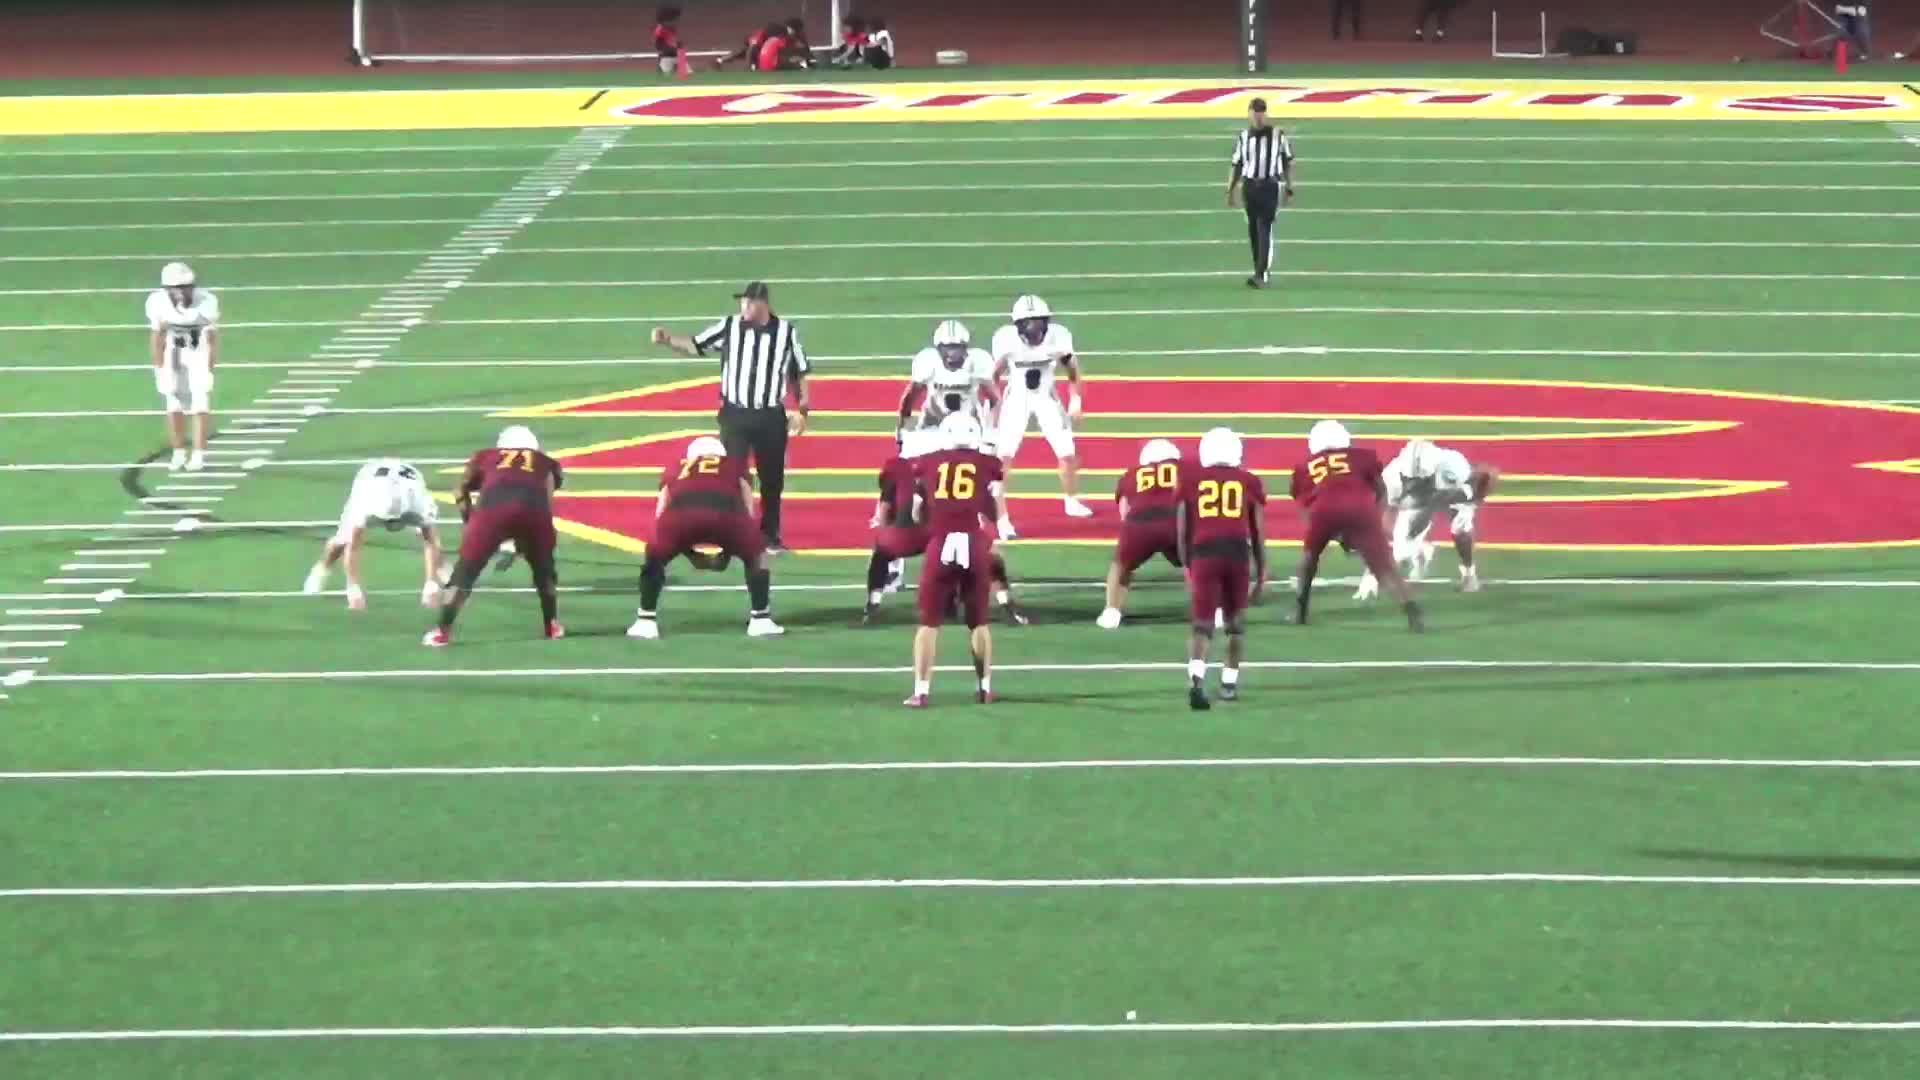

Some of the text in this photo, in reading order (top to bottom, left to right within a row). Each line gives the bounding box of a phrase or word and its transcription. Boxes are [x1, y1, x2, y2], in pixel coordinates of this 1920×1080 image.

[496, 449, 535, 473] 71
[676, 456, 721, 481] 72
[1307, 452, 1352, 485] 55
[933, 462, 977, 500] 16
[1136, 463, 1178, 493] 60
[1198, 480, 1243, 518] 20
